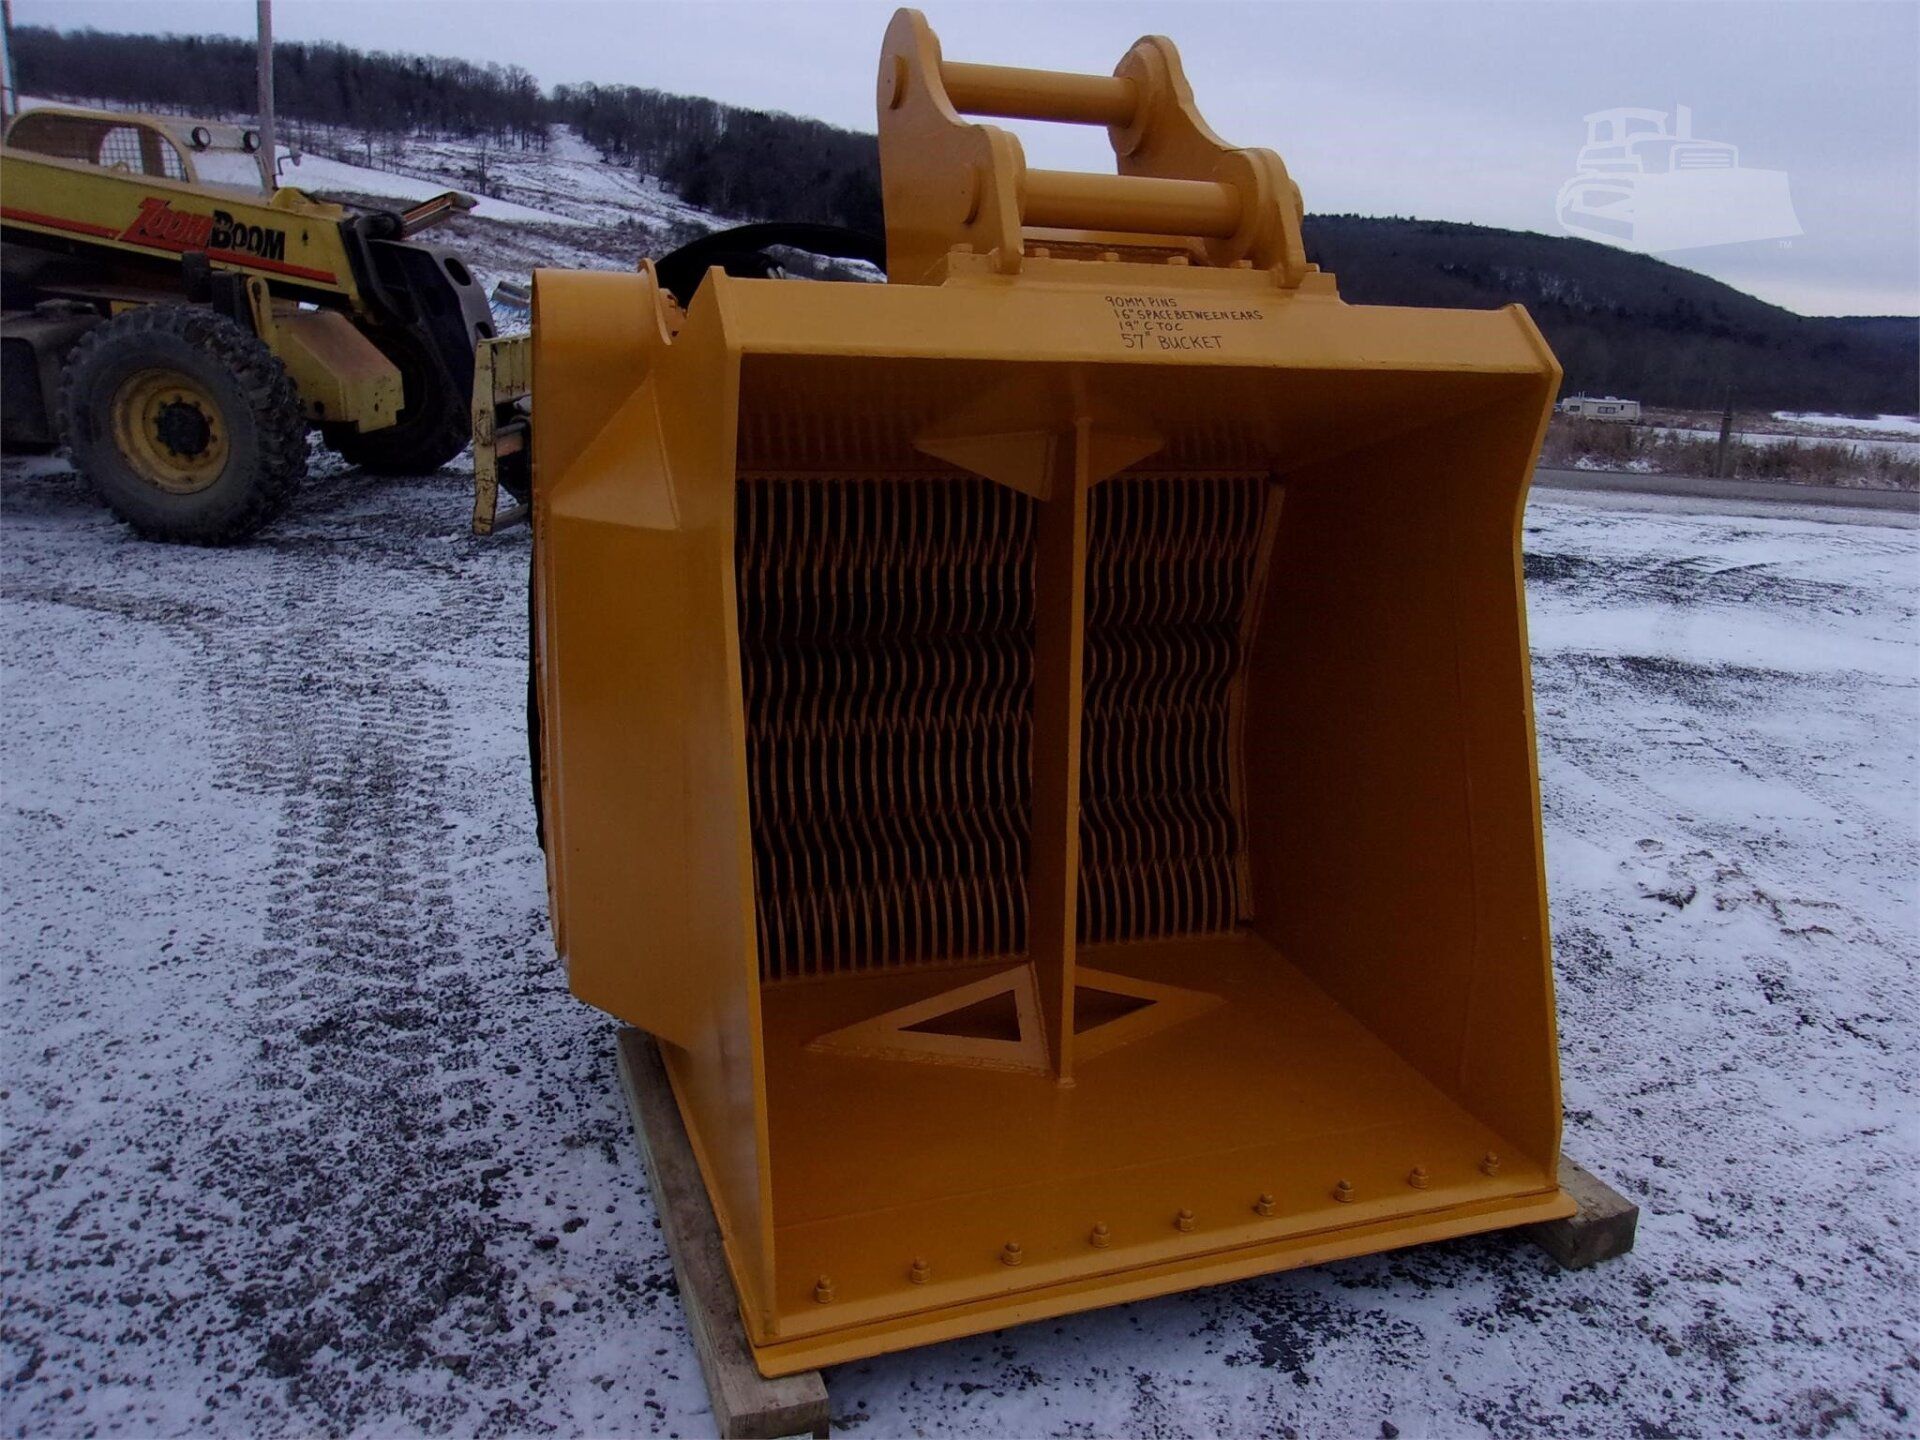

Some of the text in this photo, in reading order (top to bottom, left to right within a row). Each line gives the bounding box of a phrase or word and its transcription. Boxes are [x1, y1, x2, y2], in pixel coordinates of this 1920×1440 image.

[1105, 296, 1177, 307] 90MM PINS
[1114, 309, 1263, 320] 16" SPACE BETWEEN EARS
[1119, 320, 1139, 331] 19"
[1144, 322, 1153, 331] C
[1121, 331, 1222, 350] 57" BUCKET
